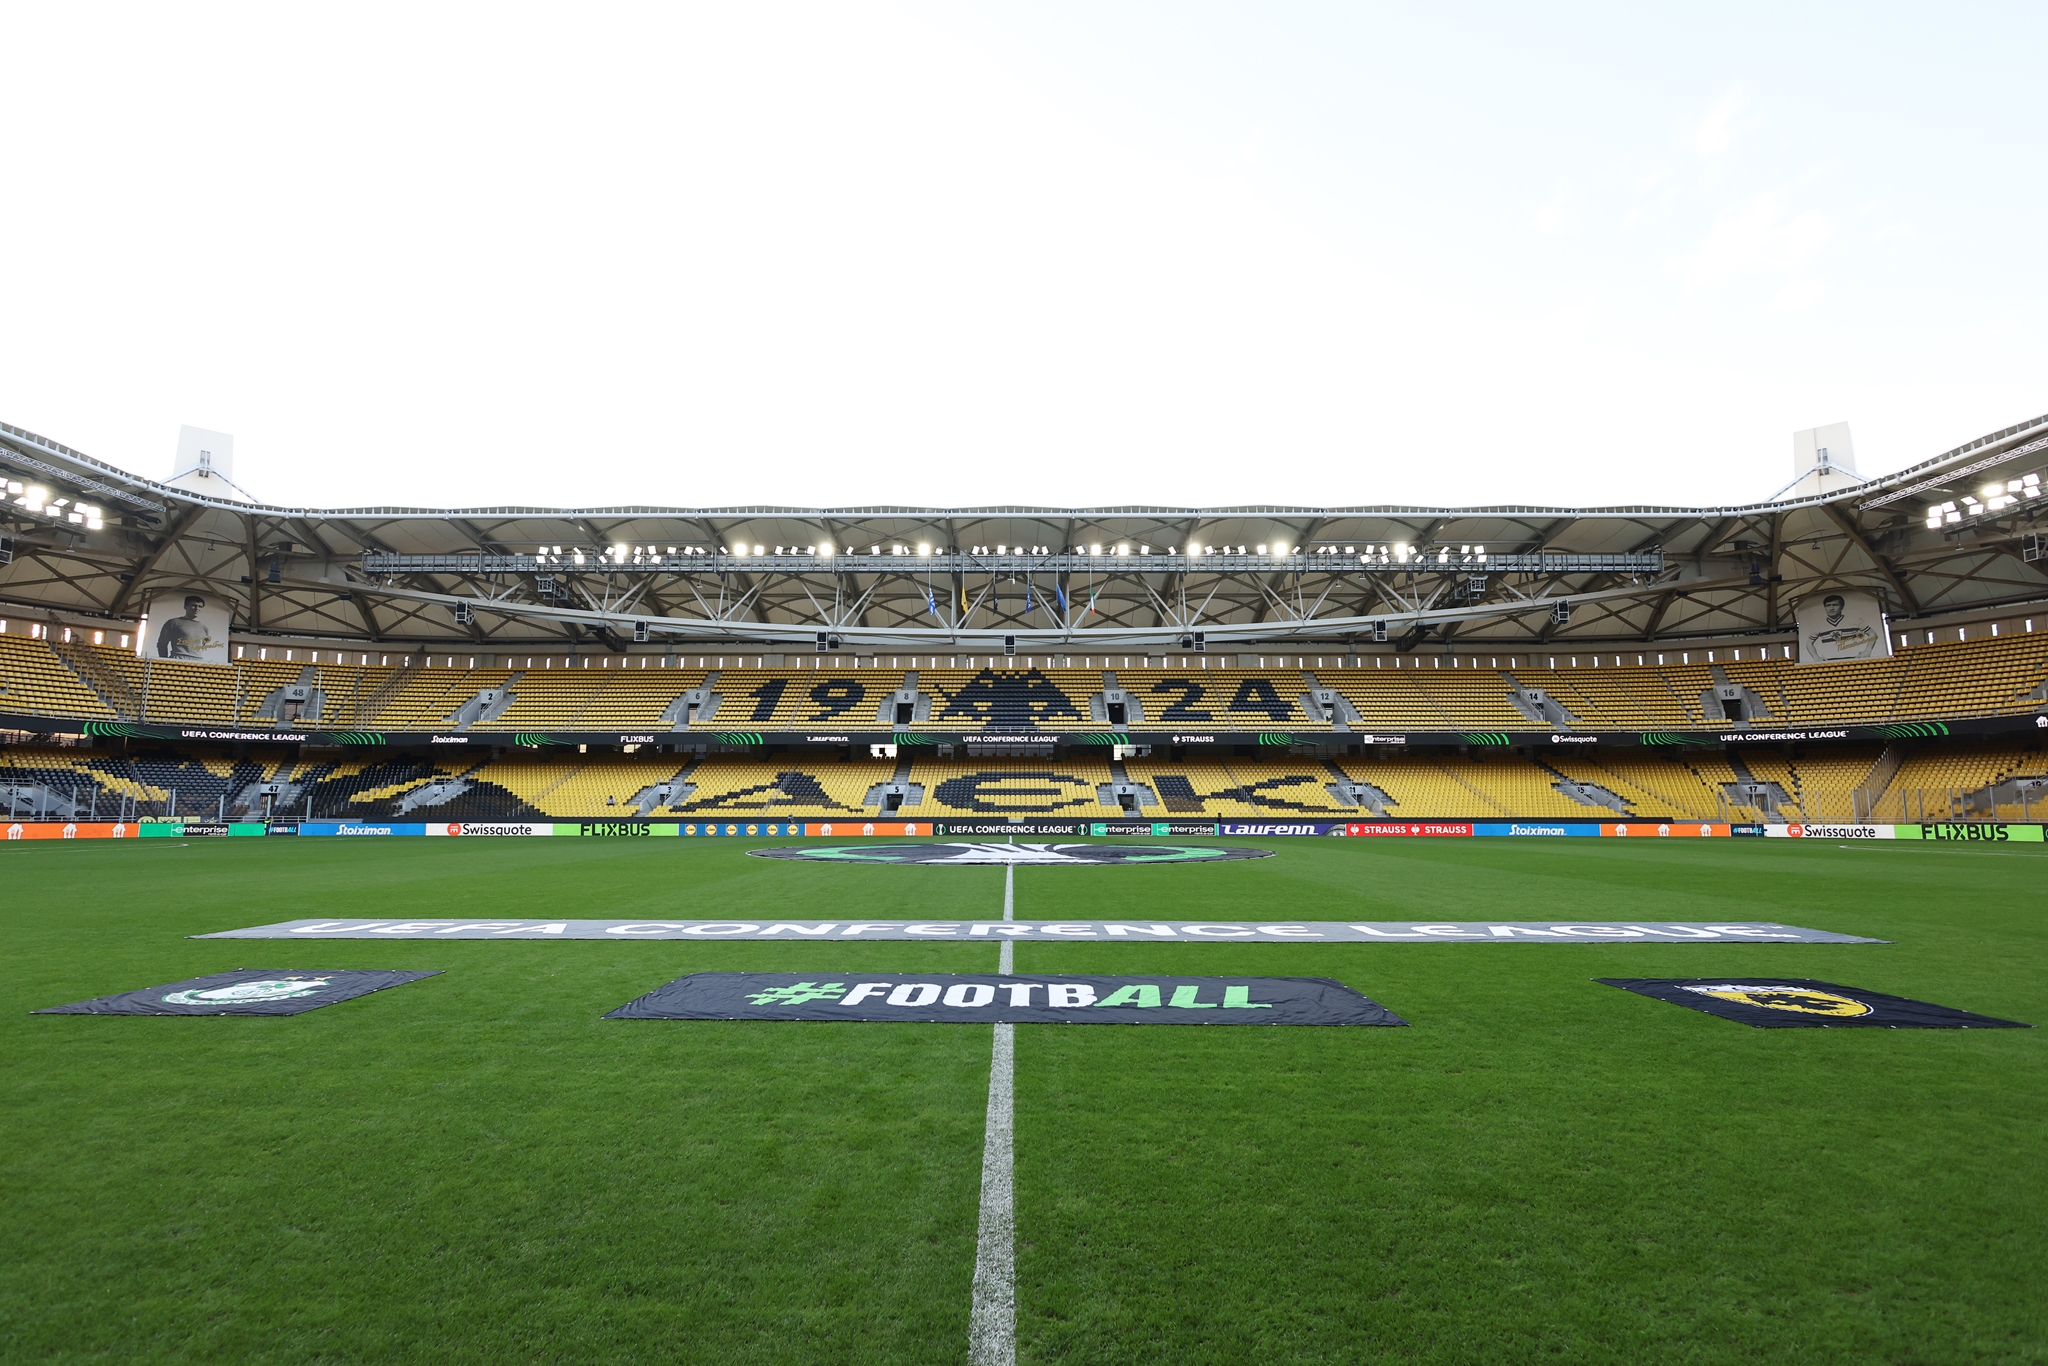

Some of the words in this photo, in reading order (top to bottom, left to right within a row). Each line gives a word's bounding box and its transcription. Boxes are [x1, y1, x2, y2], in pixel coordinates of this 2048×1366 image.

[292, 689, 304, 697] 48
[695, 692, 701, 700] 6
[904, 692, 909, 700] 8
[1110, 692, 1120, 700] 10
[1320, 692, 1330, 700] 12
[1529, 692, 1539, 700] 14
[1723, 688, 1735, 697] 16
[181, 730, 207, 739] UEFA
[208, 731, 271, 741] CONFERENCE
[272, 733, 306, 741] LEAGUE
[1560, 735, 1598, 744] Swissquote
[1720, 733, 1745, 742] UEFA
[1745, 732, 1807, 741] CONFERENCE
[1808, 730, 1847, 740] LEAGUE
[268, 785, 280, 793] 47
[172, 825, 228, 835] enterprise
[336, 824, 392, 836] Stoiximan
[462, 824, 532, 837] Swissquote
[949, 825, 974, 834] UEFA
[975, 825, 1036, 834] CONFERENCE
[1037, 825, 1074, 834] LEAGUE
[1095, 825, 1151, 835] enterprise
[1158, 825, 1214, 835] enterprise
[1364, 825, 1406, 834] STRAUSS
[1424, 825, 1467, 834] STRAUSS
[1509, 824, 1565, 836] Stoiximan
[1804, 824, 1876, 839] Swissquote
[289, 922, 568, 935] UEFA
[605, 922, 1325, 937] CONFERENCE
[1348, 924, 1801, 938] LEAGUE
[744, 982, 1272, 1008] #FOOTBALL
